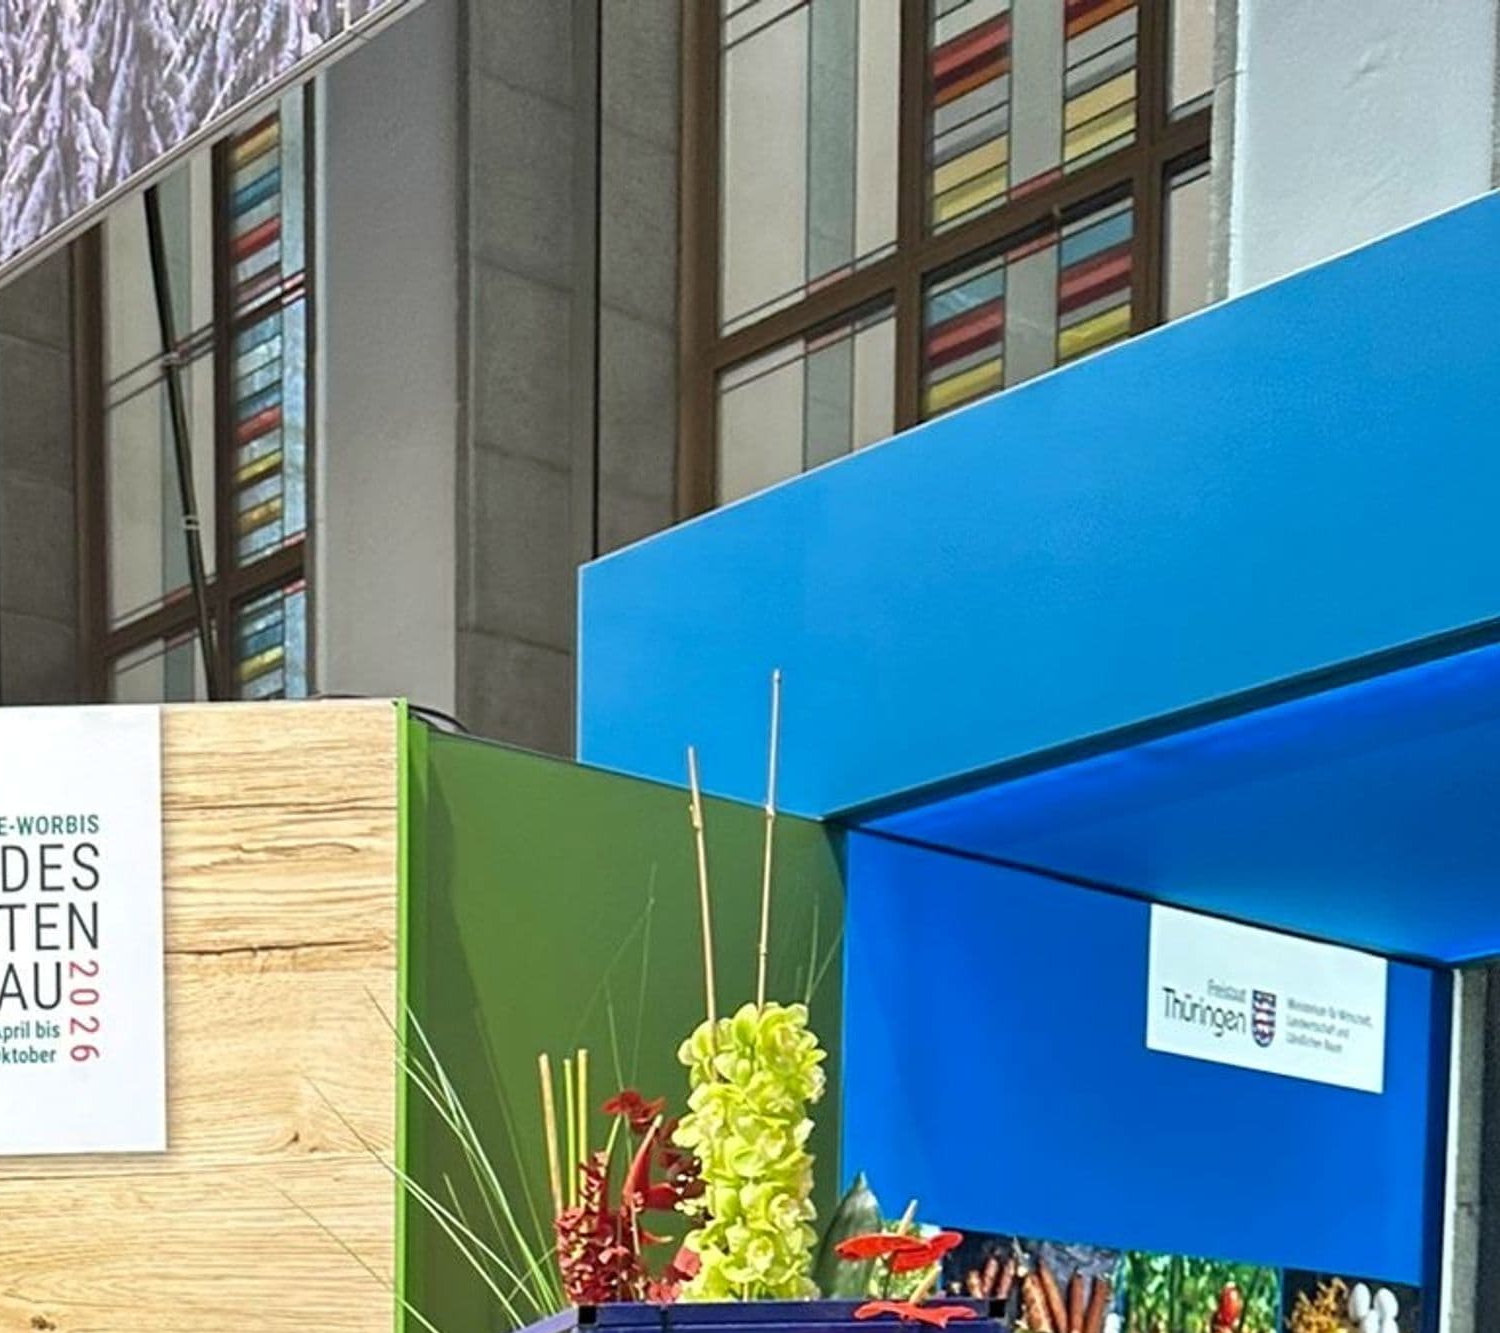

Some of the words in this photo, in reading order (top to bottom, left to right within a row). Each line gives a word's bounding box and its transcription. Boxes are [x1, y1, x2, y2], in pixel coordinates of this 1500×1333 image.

[35, 1020, 61, 1039] bis
[69, 959, 100, 1063] 2026
[1162, 986, 1247, 1038] Thüringen
